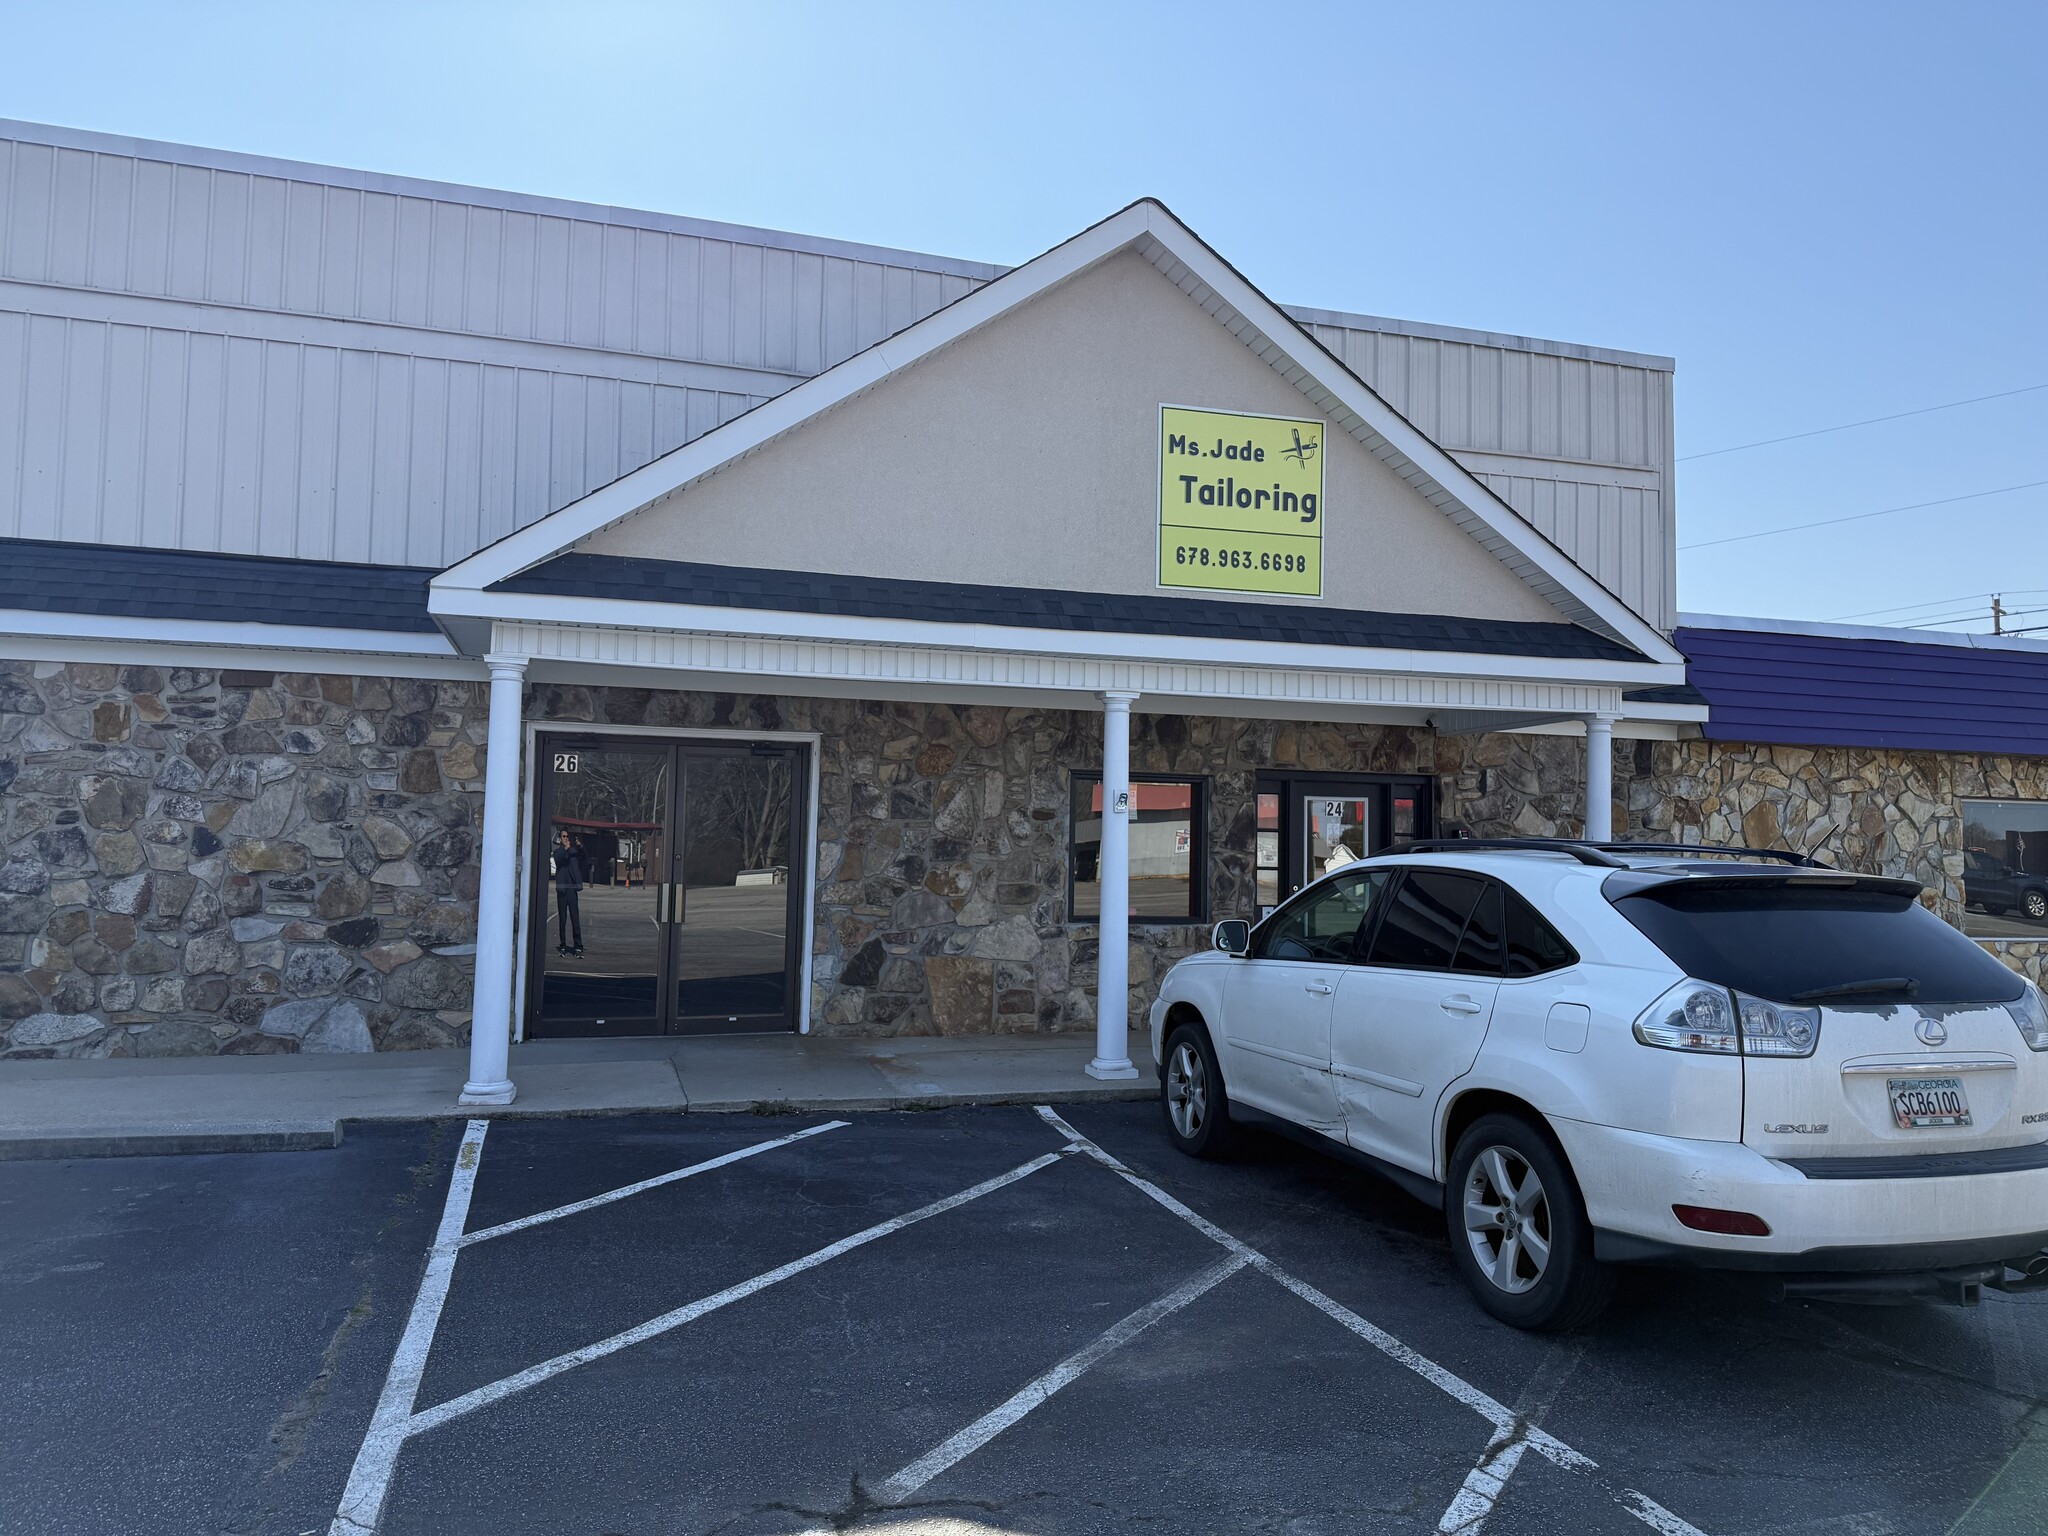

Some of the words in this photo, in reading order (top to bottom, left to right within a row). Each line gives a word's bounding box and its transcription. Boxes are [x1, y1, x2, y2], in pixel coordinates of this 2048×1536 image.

[1179, 474, 1317, 523] Tailoring
[1176, 545, 1306, 573] 678.963.6698
[555, 755, 577, 772] 26
[1326, 801, 1342, 817] 24
[1918, 1079, 1958, 1090] GEORGIA
[1899, 1090, 1961, 1116] SCB6100
[1763, 1123, 1829, 1134] LEXUS
